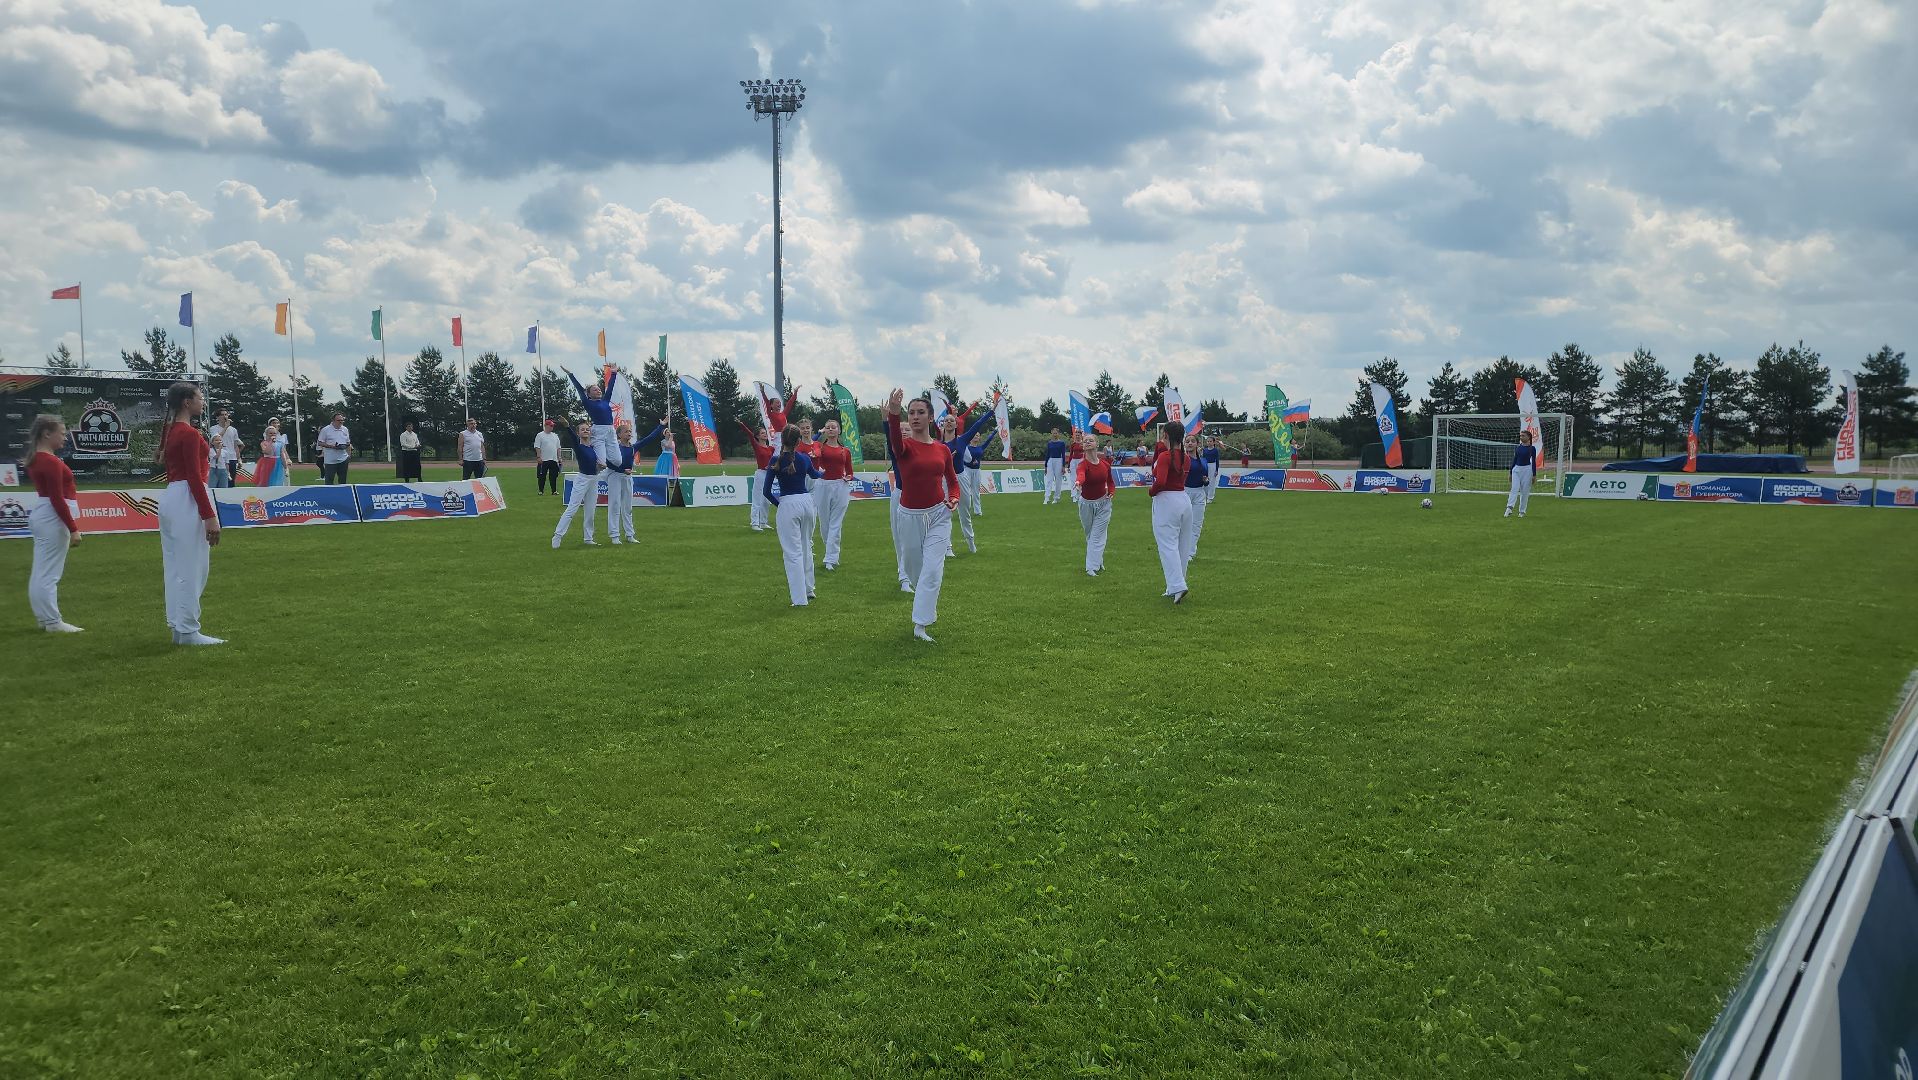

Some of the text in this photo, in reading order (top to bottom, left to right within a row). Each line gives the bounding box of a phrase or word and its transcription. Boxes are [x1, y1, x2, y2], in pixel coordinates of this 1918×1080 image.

[77, 433, 125, 442] МАТЧ ЛЕГЕНД
[371, 493, 424, 502] МОСОБЛ
[272, 500, 319, 508] КОМАНДА
[373, 501, 414, 510] СПОРТ
[82, 507, 127, 518] ПОБЕДА!
[274, 509, 338, 518] ГУБЕРНАТОРА
